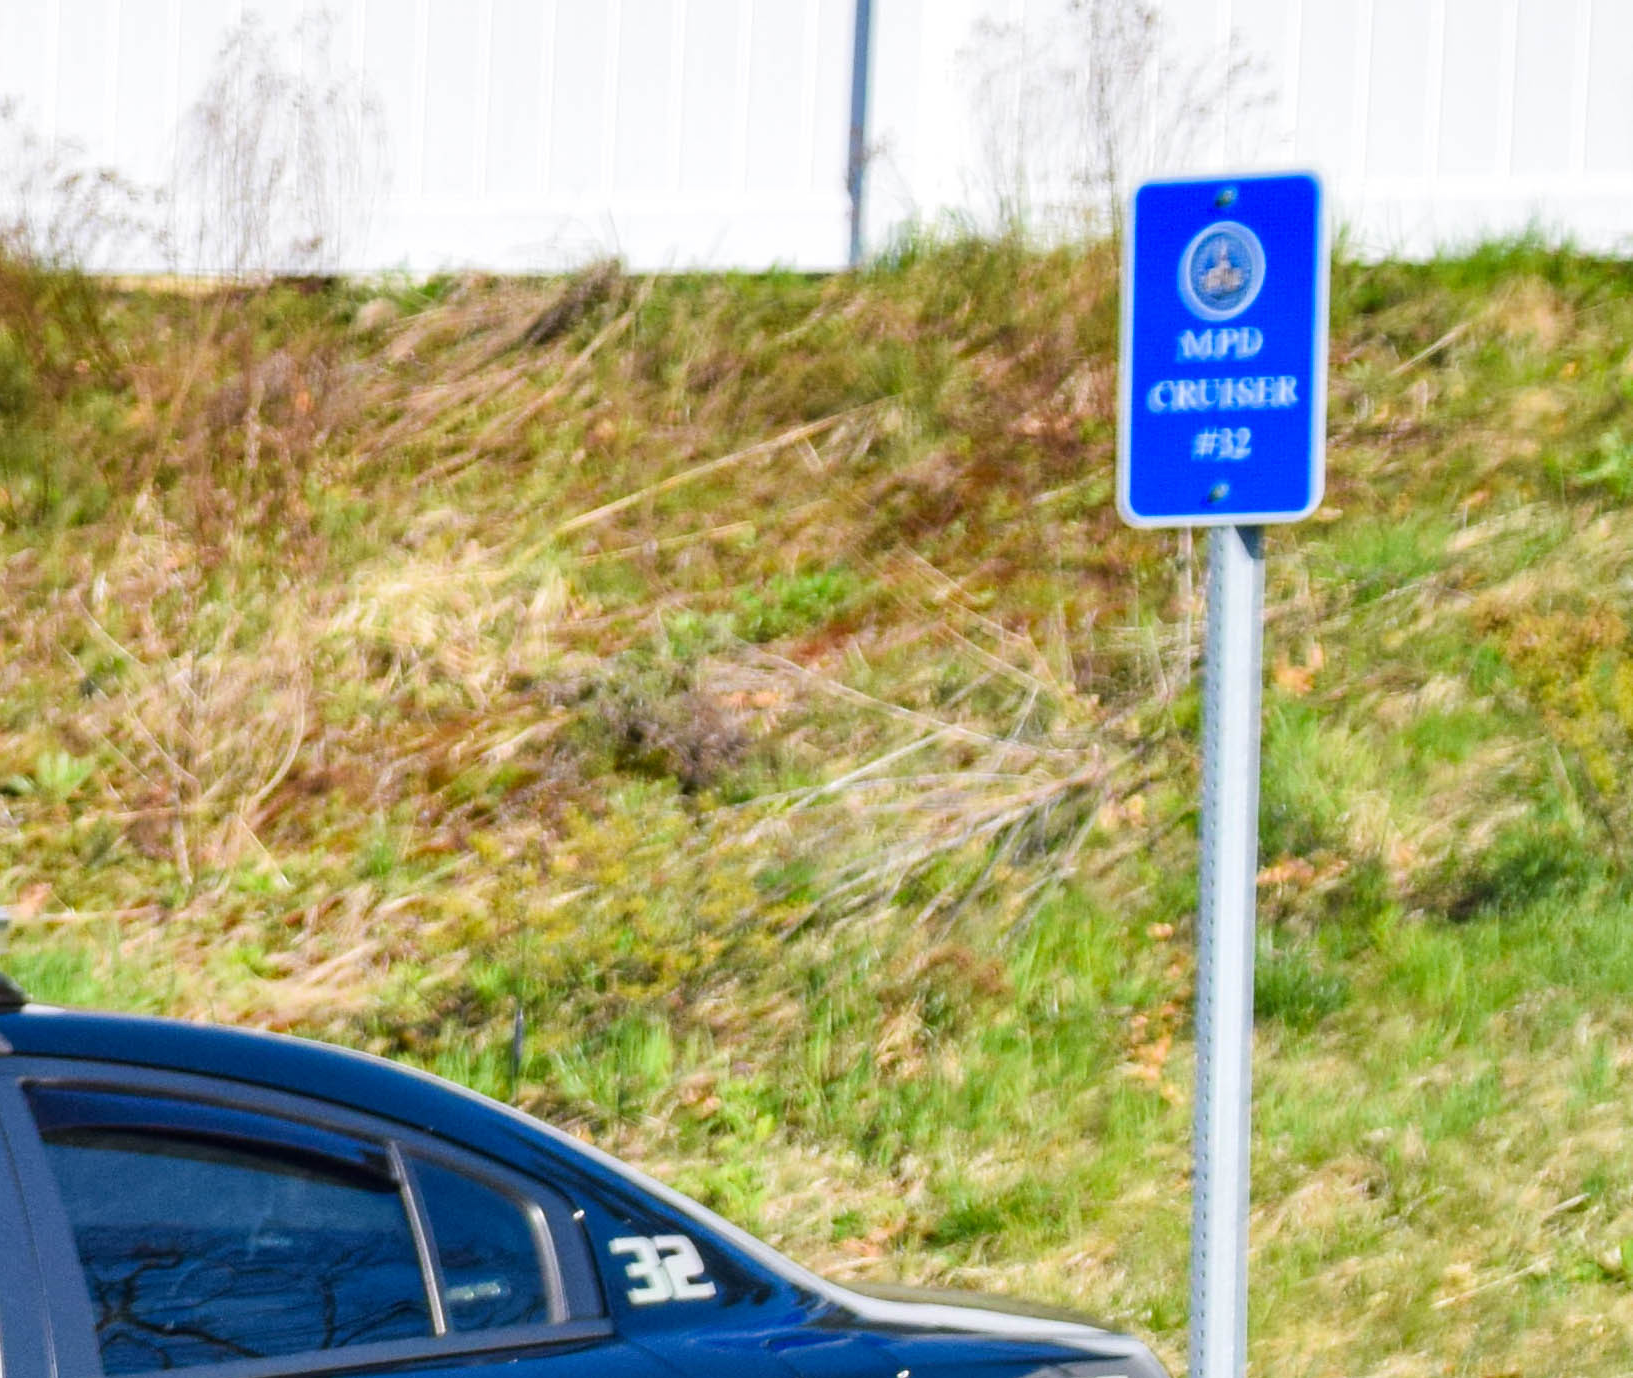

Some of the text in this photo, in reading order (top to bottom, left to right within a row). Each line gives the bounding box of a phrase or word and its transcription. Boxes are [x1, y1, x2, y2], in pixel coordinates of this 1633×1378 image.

[1179, 327, 1264, 359] MPD
[1149, 375, 1298, 413] CRUISER
[1194, 427, 1253, 460] #32
[609, 1234, 716, 1305] 32
